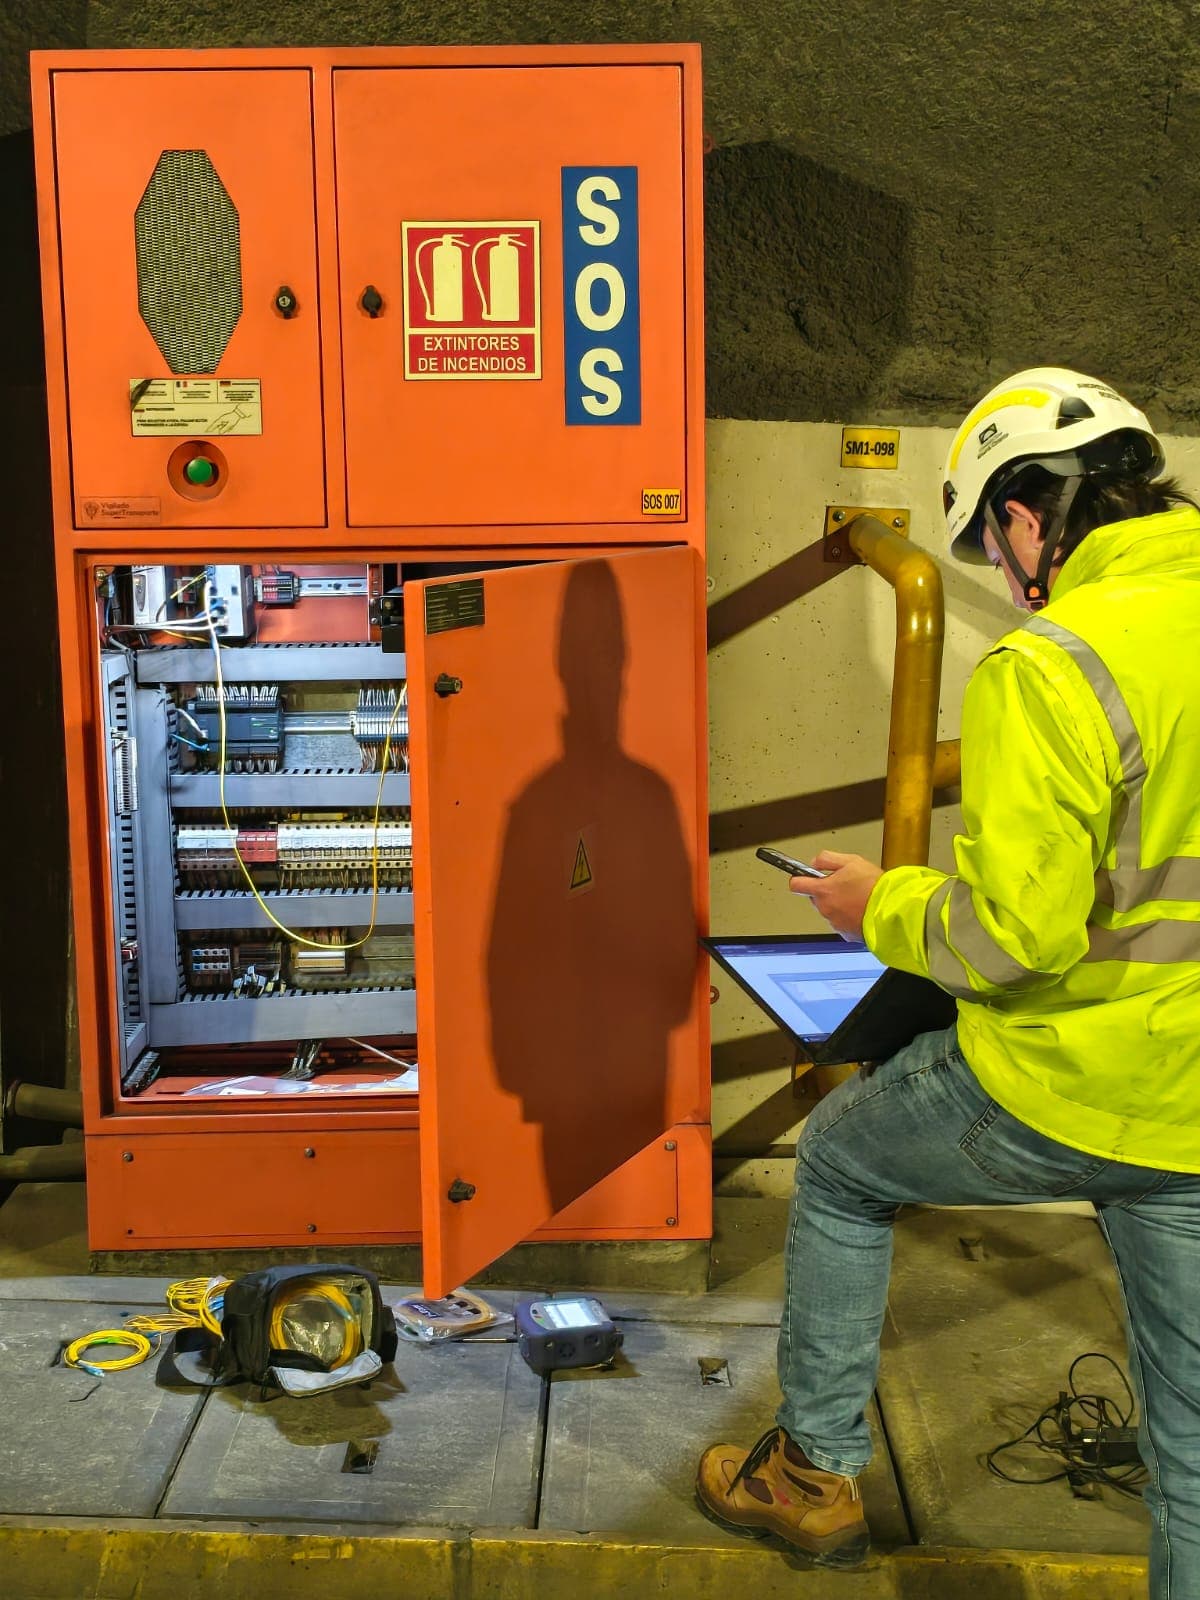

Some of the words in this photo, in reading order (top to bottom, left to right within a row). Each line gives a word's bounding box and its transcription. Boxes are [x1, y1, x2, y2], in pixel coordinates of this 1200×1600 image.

[574, 176, 626, 417] SOS
[423, 336, 520, 351] EXTINTORES
[418, 357, 438, 371] DE
[443, 356, 527, 371] INCENDIOS
[845, 440, 895, 456] SM1-098
[643, 494, 662, 509] SOS
[665, 494, 680, 509] 007
